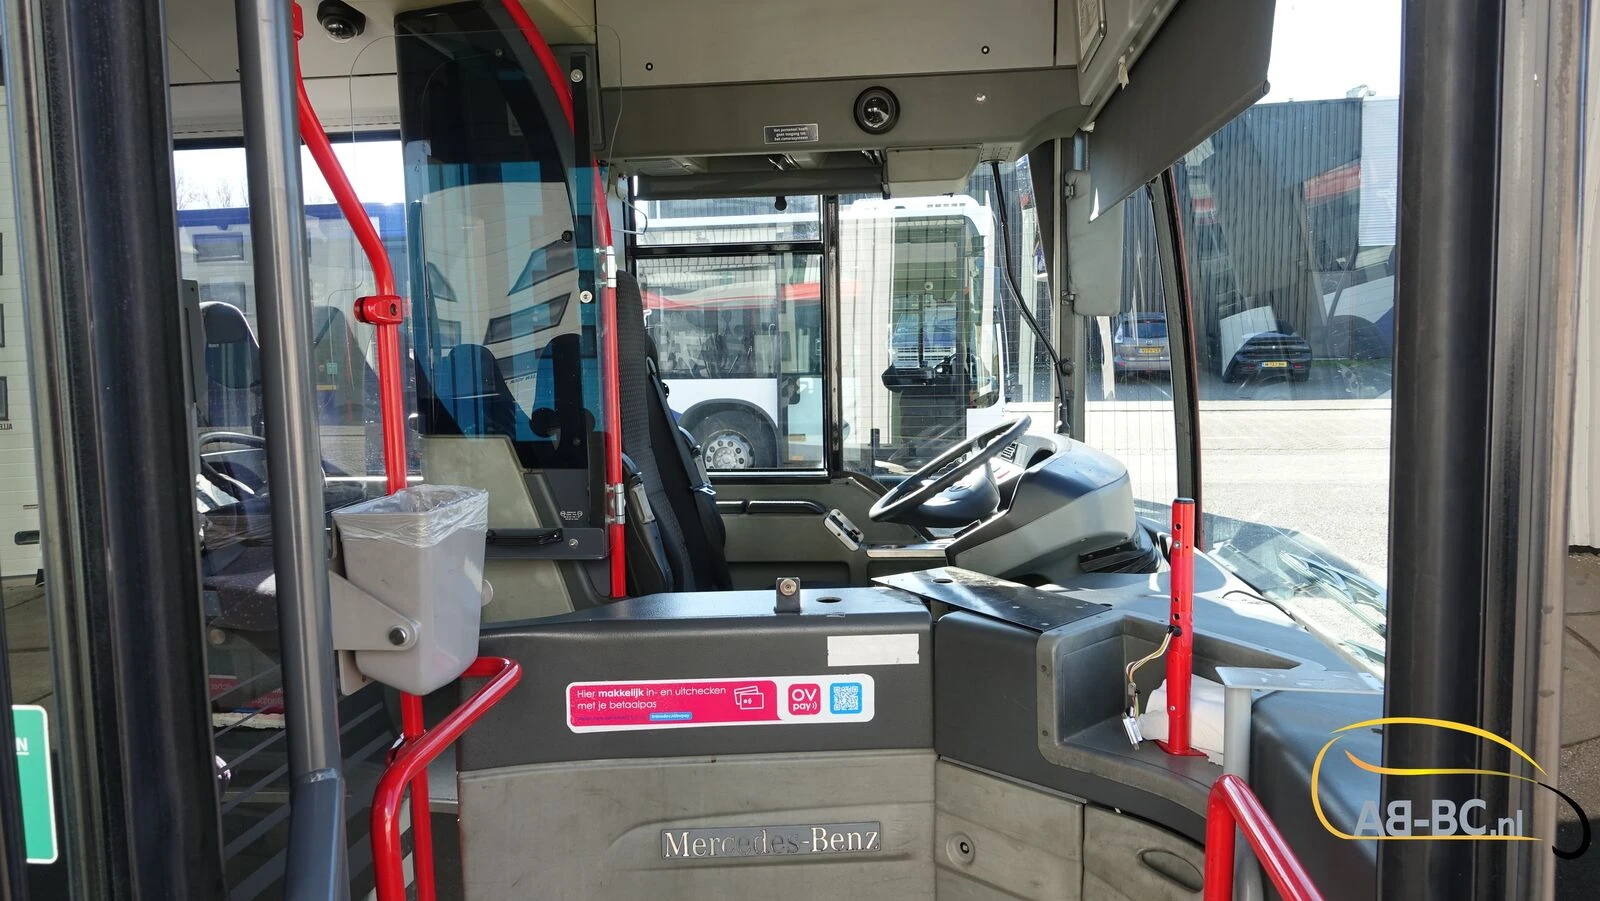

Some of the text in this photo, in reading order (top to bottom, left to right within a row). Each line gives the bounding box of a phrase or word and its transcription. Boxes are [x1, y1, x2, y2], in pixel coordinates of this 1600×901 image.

[577, 689, 596, 698] Hier
[598, 688, 644, 699] makkelijk
[646, 688, 657, 697] in-
[675, 686, 726, 696] uitchecken
[791, 688, 817, 702] OV
[577, 699, 657, 711] met je betaalpas
[793, 702, 811, 711] pay
[664, 827, 879, 858] Mercedes-Benz
